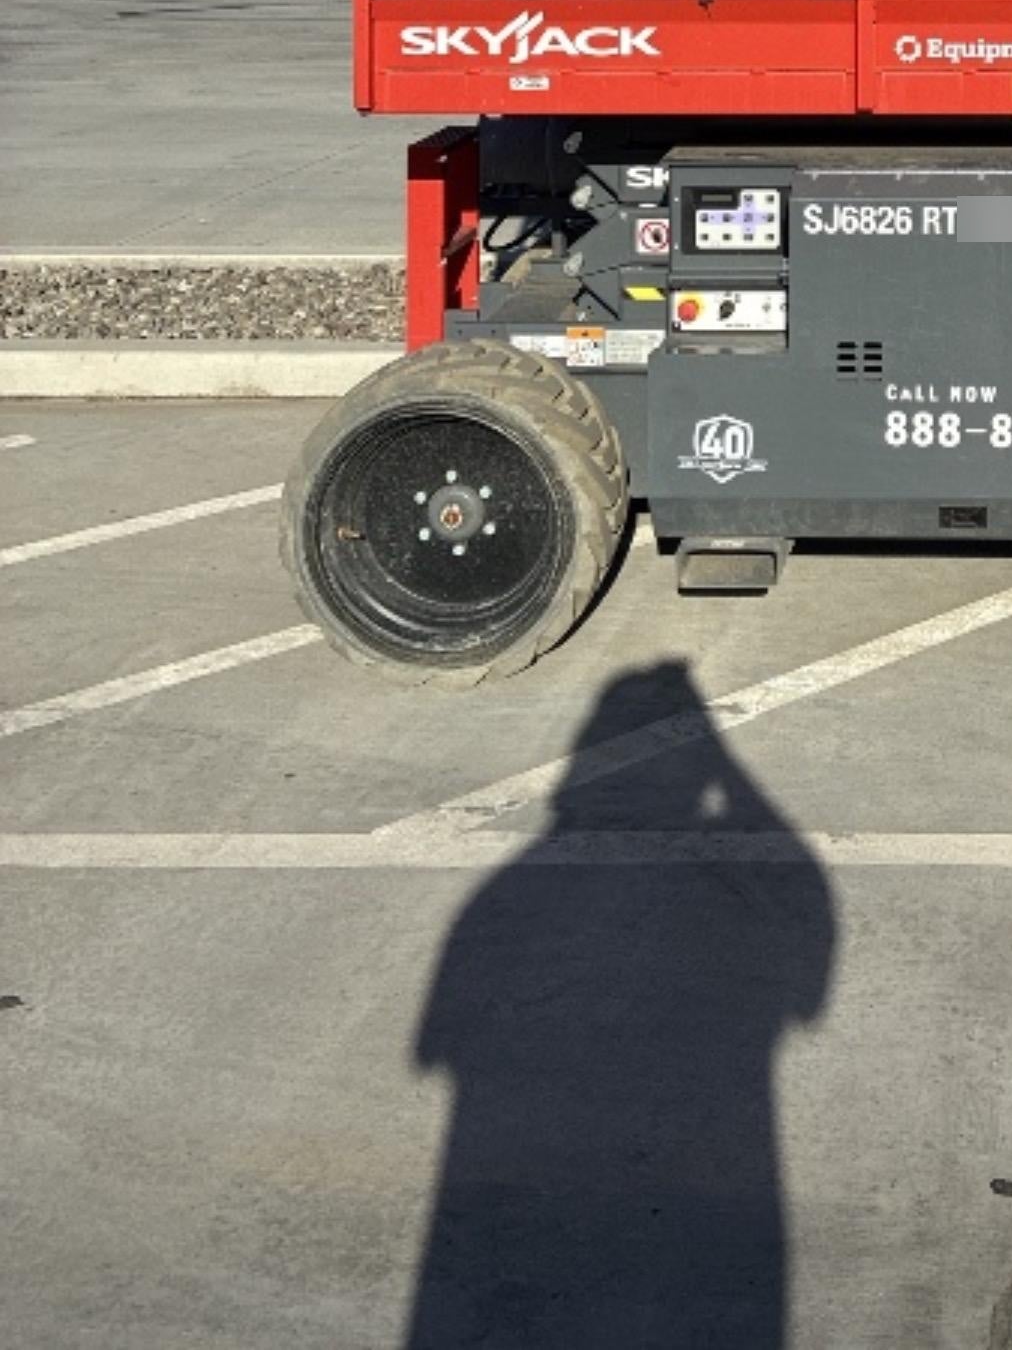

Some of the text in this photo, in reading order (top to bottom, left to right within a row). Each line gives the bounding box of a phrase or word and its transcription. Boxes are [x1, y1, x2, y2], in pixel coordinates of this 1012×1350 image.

[401, 11, 660, 63] SKYJACK
[803, 205, 913, 236] SJ6826
[923, 206, 957, 235] RT
[951, 385, 997, 402] NOW
[701, 423, 746, 459] 40
